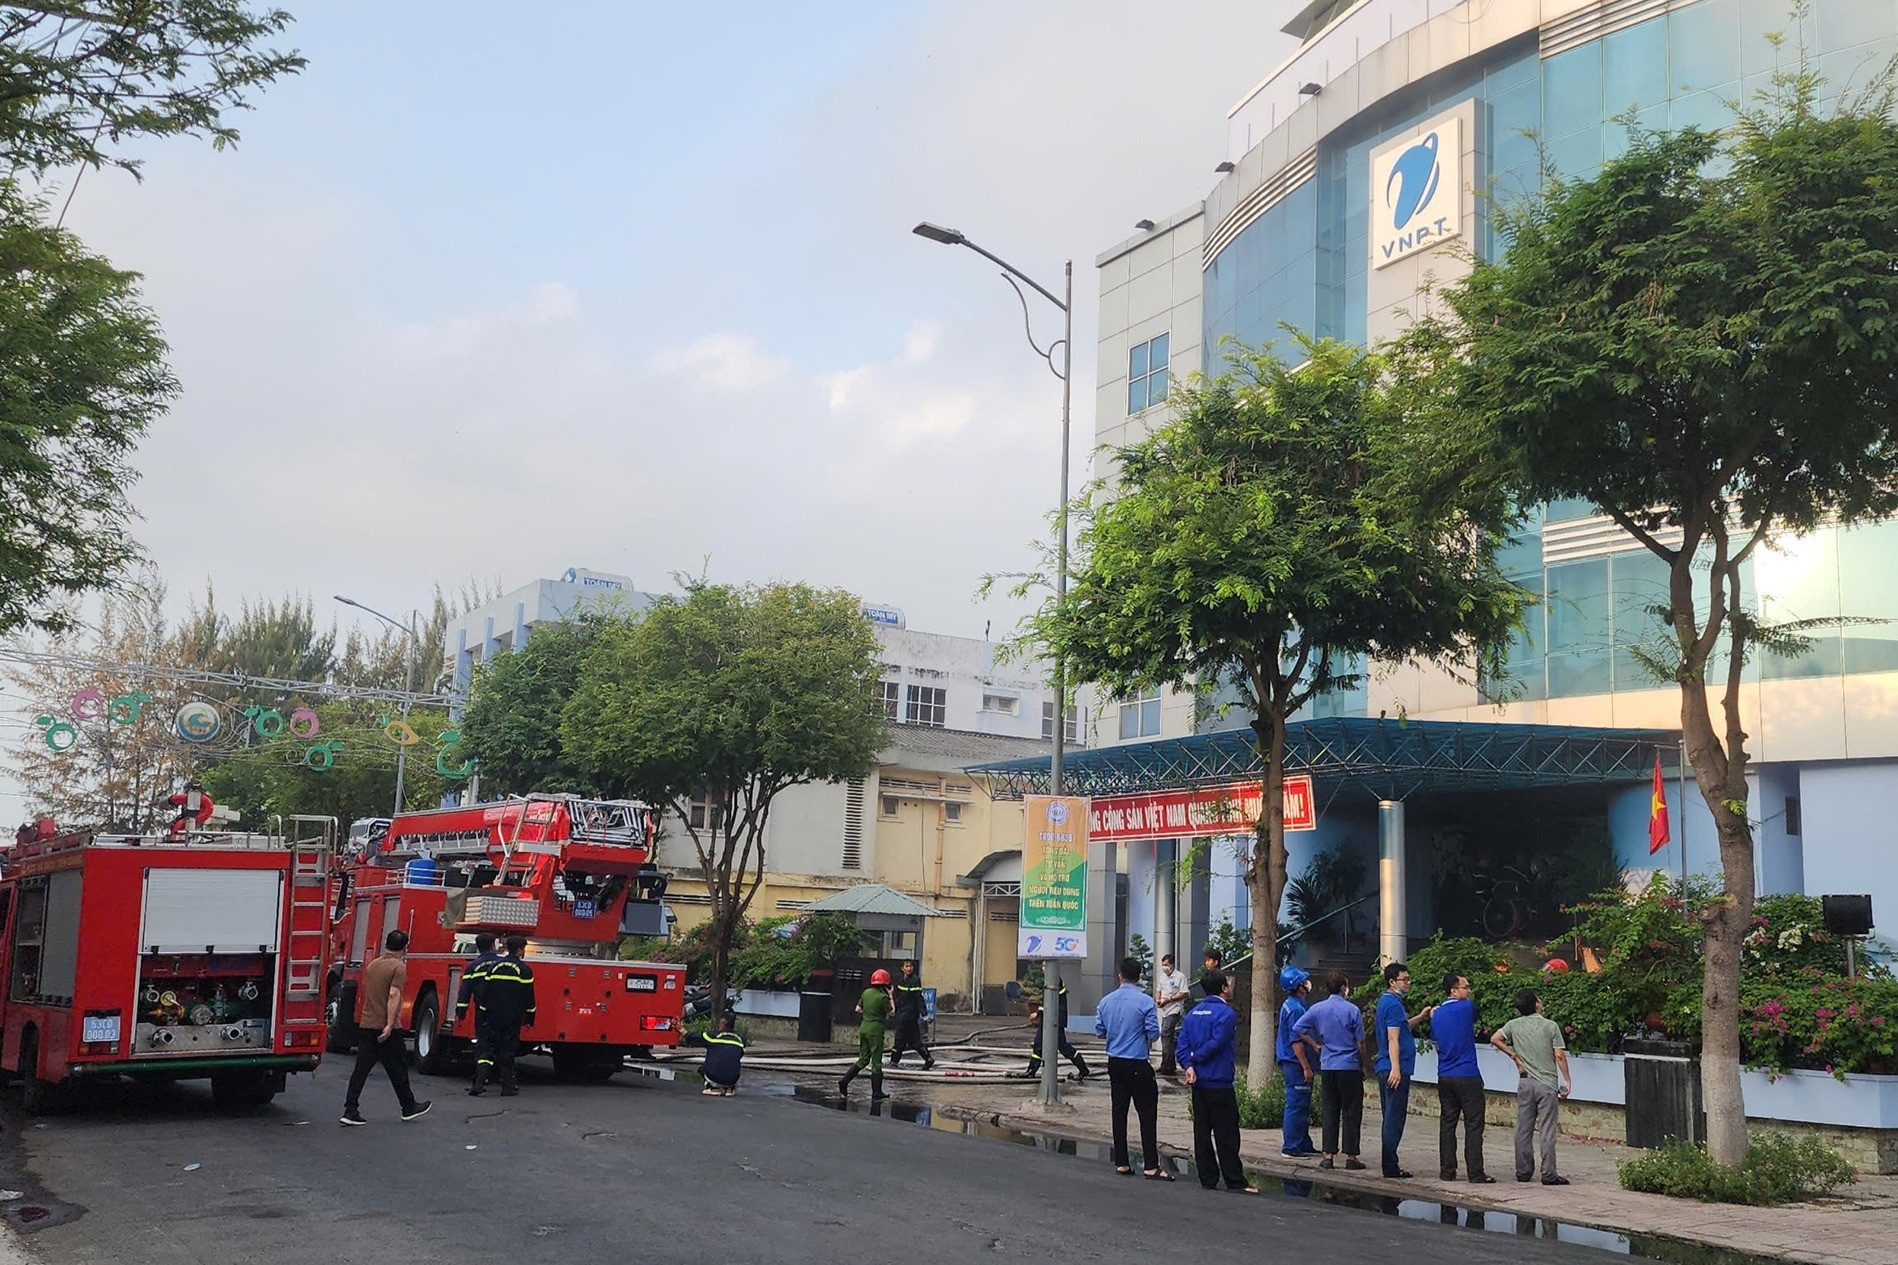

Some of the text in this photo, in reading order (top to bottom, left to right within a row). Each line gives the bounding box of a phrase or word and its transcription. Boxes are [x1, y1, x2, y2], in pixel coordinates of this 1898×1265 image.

[1382, 217, 1446, 258] VNPT
[1103, 804, 1125, 835] CỘNG
[1126, 801, 1143, 829] SẢN
[1145, 801, 1164, 831] VIỆT
[1166, 803, 1187, 828] NAM
[1282, 790, 1306, 819] ĂM!
